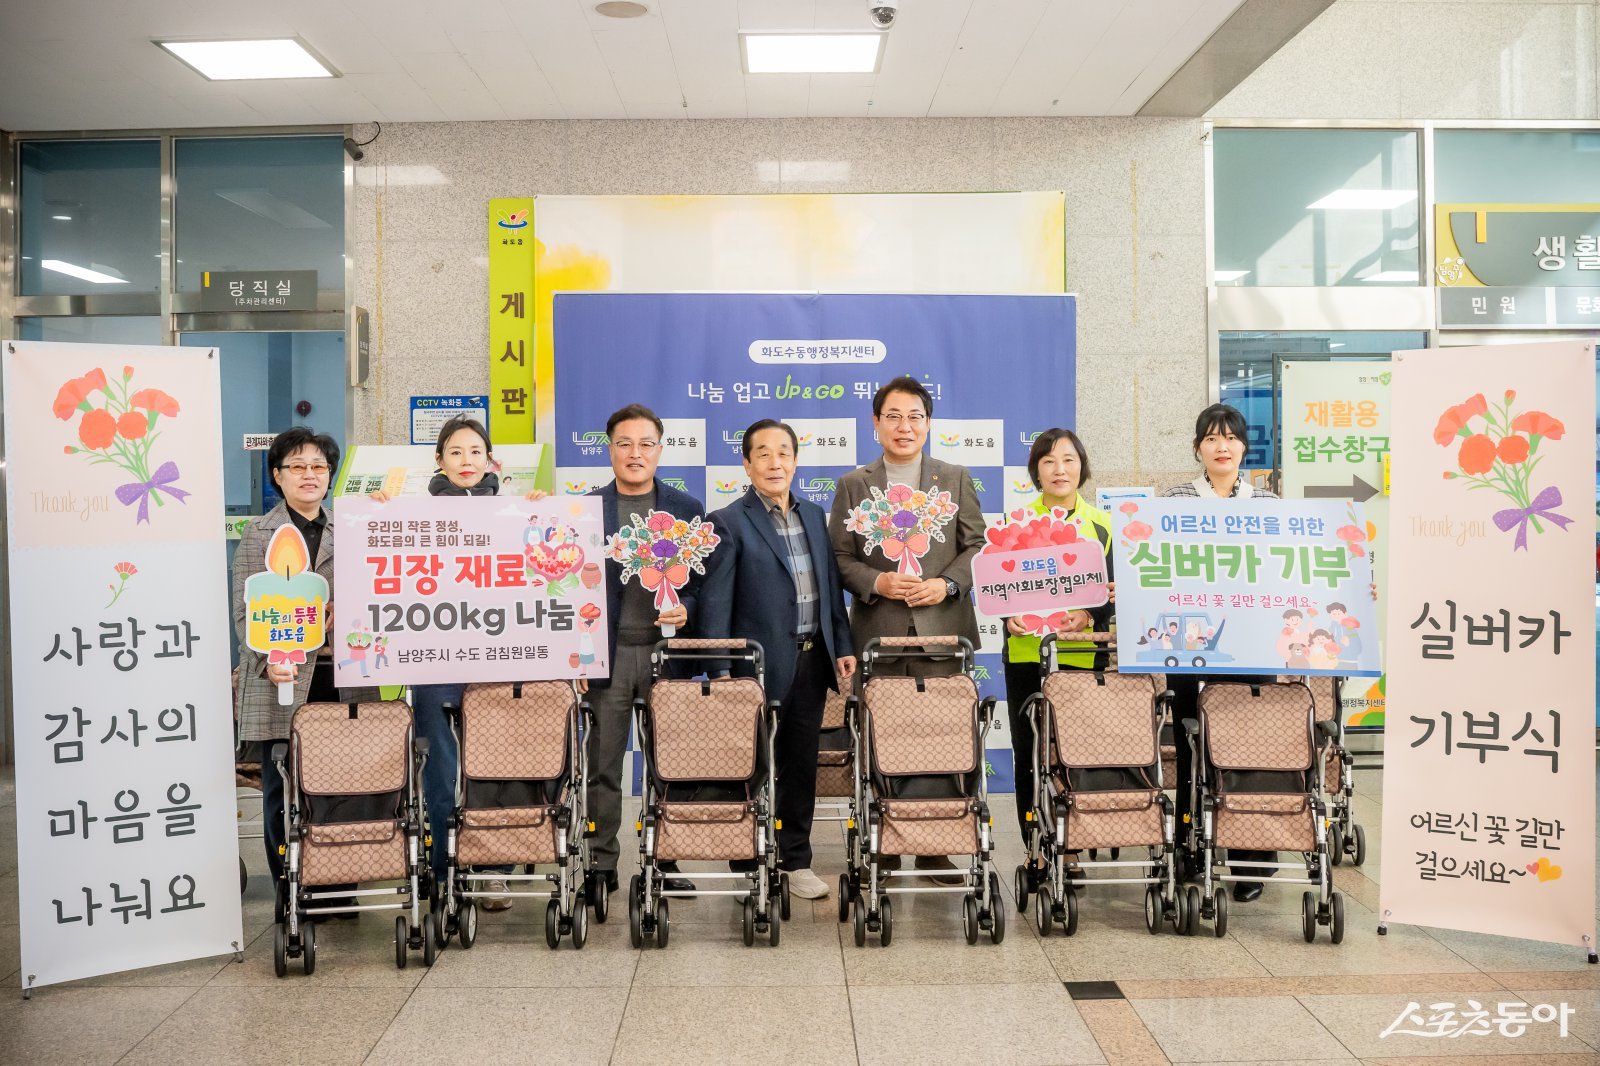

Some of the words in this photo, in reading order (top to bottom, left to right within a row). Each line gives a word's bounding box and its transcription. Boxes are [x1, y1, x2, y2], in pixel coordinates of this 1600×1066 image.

[229, 279, 291, 297] 당직실
[1471, 296, 1516, 315] 민원
[500, 291, 528, 416] 게시판
[761, 345, 875, 359] 화도수동행정복지센터
[417, 399, 439, 407] CCTV
[441, 398, 463, 407] 녹화중
[687, 382, 726, 403] 나눔
[732, 382, 771, 402] 업고
[1303, 400, 1380, 429] 재활용
[581, 446, 604, 456] 남양주
[666, 437, 698, 448] 화도읍
[816, 436, 848, 447] 화도읍
[964, 437, 995, 448] 화도읍
[1293, 435, 1391, 464] 접수창구
[31, 490, 80, 513] Thank
[80, 495, 111, 521] you
[808, 493, 830, 502] 남양주
[367, 520, 403, 534] 우리의
[408, 519, 432, 533] 작은
[435, 520, 464, 533] 정성,
[1161, 514, 1217, 534] 어르신
[1224, 515, 1281, 536] 안전을
[1288, 517, 1325, 537] 위한
[1409, 514, 1455, 538] Thank
[1455, 518, 1488, 547] you
[367, 534, 415, 549] 화도읍의
[420, 535, 432, 547] 큰
[436, 534, 460, 548] 힘이
[463, 534, 491, 547] 되길!
[366, 554, 444, 596] 김장
[454, 553, 528, 589] 재료
[1021, 557, 1057, 576] 화도읍
[1129, 542, 1262, 589] 실버카
[1270, 545, 1351, 589] 기부
[981, 571, 1103, 601] 지역사회보장협의체
[1168, 593, 1208, 608] 어르신
[1212, 594, 1226, 608] 꽃
[1229, 594, 1256, 608] 길만
[1260, 594, 1319, 609] 걸으세요~
[252, 607, 292, 625] 나눔의
[294, 606, 318, 625] 등불
[367, 600, 506, 636] 1200kg
[515, 598, 575, 631] 나눔
[270, 626, 305, 643] 화도읍
[979, 624, 998, 635] 도읍
[1410, 599, 1572, 660] 실버카
[43, 616, 201, 672] 사랑과
[398, 648, 450, 663] 남양주시
[455, 647, 481, 662] 수도
[485, 646, 549, 661] 검침원일동
[44, 703, 197, 764] 감사의
[1410, 709, 1561, 774] 기부식
[48, 782, 202, 844] 마음을
[1410, 811, 1478, 842] 어르신
[1484, 815, 1510, 845] 꽃
[1515, 817, 1565, 851] 길만
[1415, 850, 1527, 884] 걸으세요~
[51, 874, 206, 927] 나눠요
